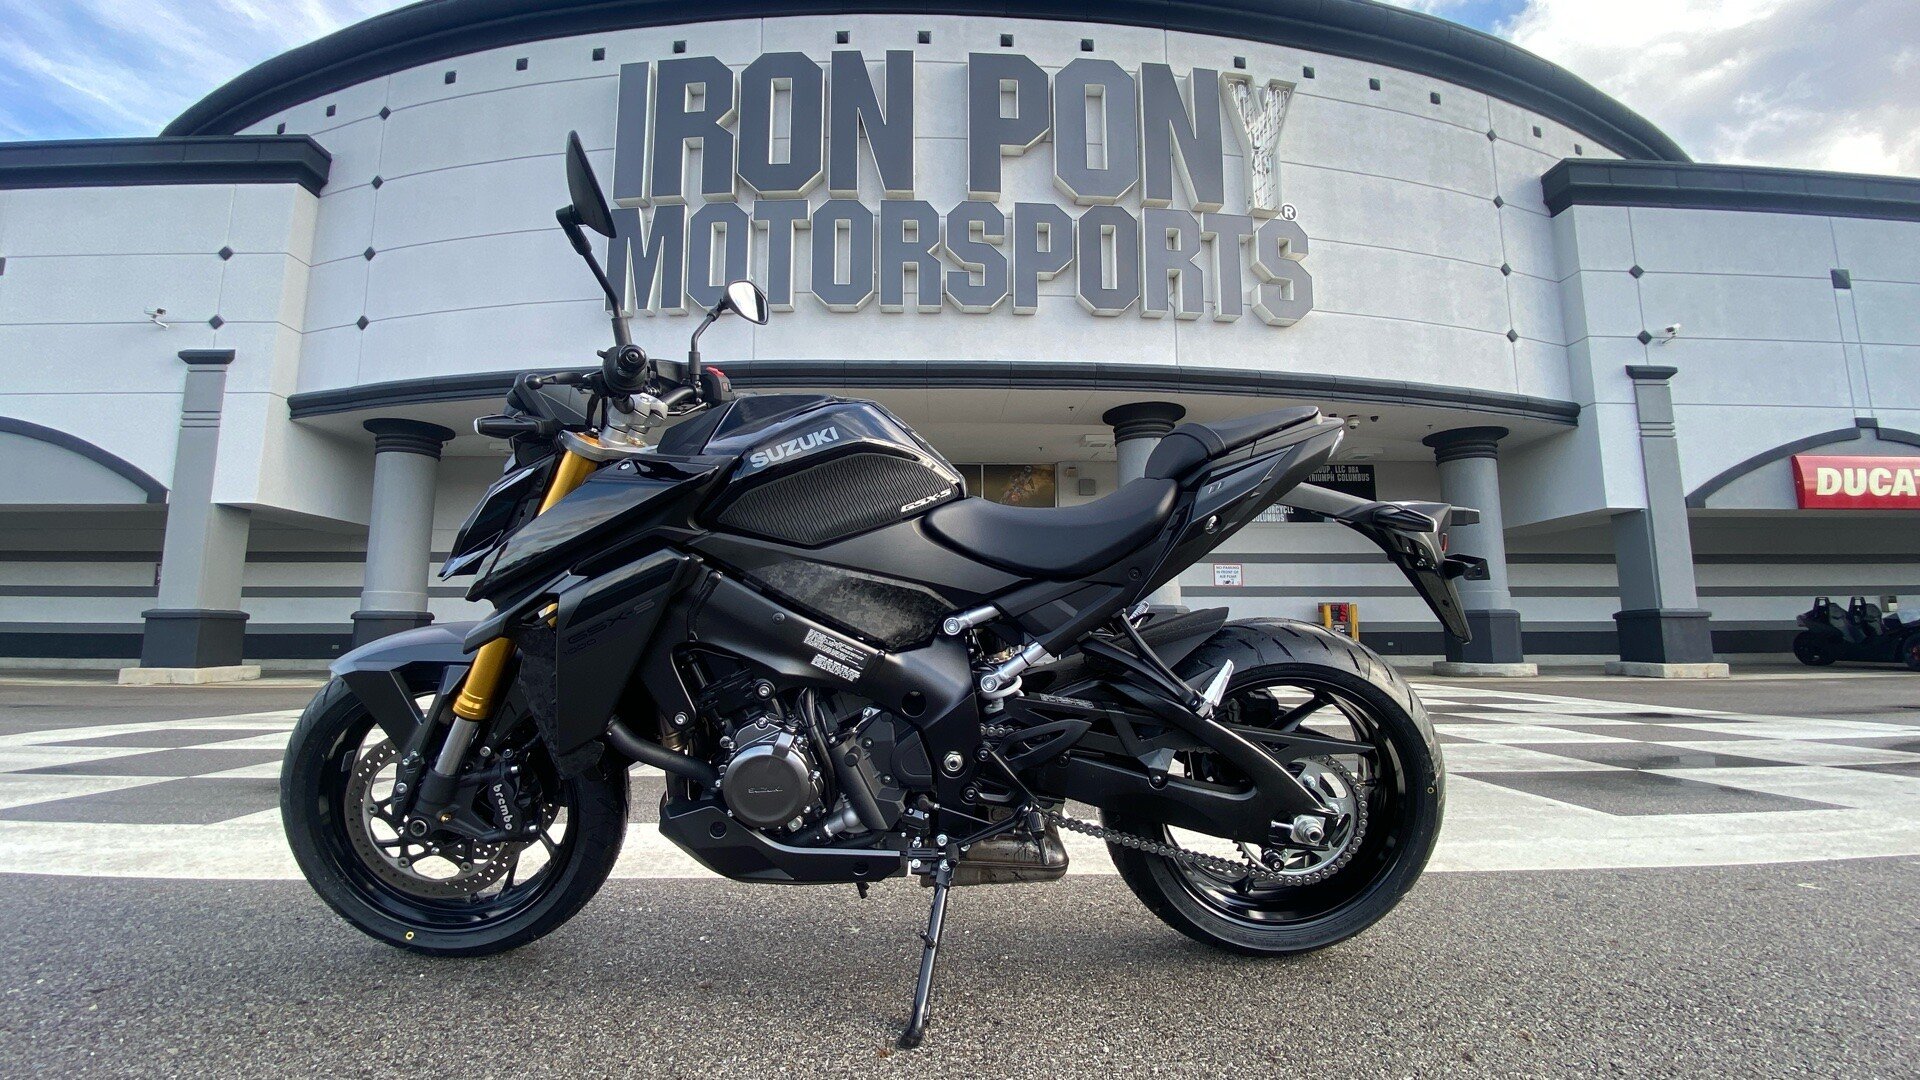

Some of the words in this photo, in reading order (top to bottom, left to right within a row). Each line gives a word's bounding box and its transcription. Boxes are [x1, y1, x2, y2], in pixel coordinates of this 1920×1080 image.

[611, 50, 914, 202] IRON
[967, 51, 1297, 217] PONY
[603, 200, 1313, 326] MOTORSPORTS
[750, 426, 840, 468] SUZUKI
[1308, 473, 1335, 482] TRIUMPH
[1337, 473, 1370, 482] COLUMBUS
[1334, 465, 1346, 474] LLC
[1816, 467, 1920, 496] DUCA
[493, 784, 513, 830] brembo
